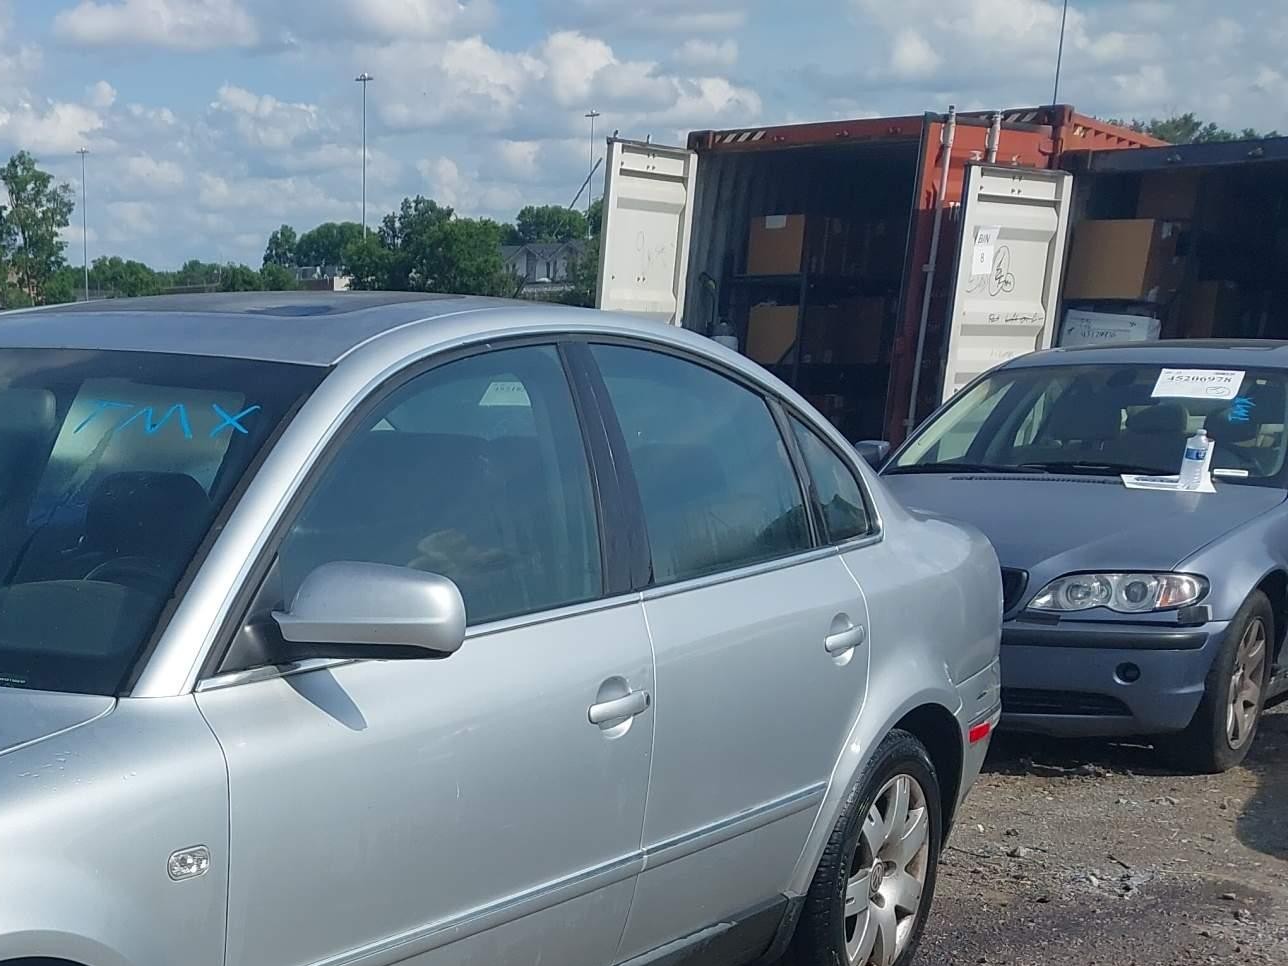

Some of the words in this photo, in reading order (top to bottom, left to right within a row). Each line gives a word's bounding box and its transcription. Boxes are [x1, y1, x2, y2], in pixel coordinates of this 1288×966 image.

[978, 234, 990, 244] BIN
[979, 252, 985, 264] 8
[73, 398, 262, 440] TMX
